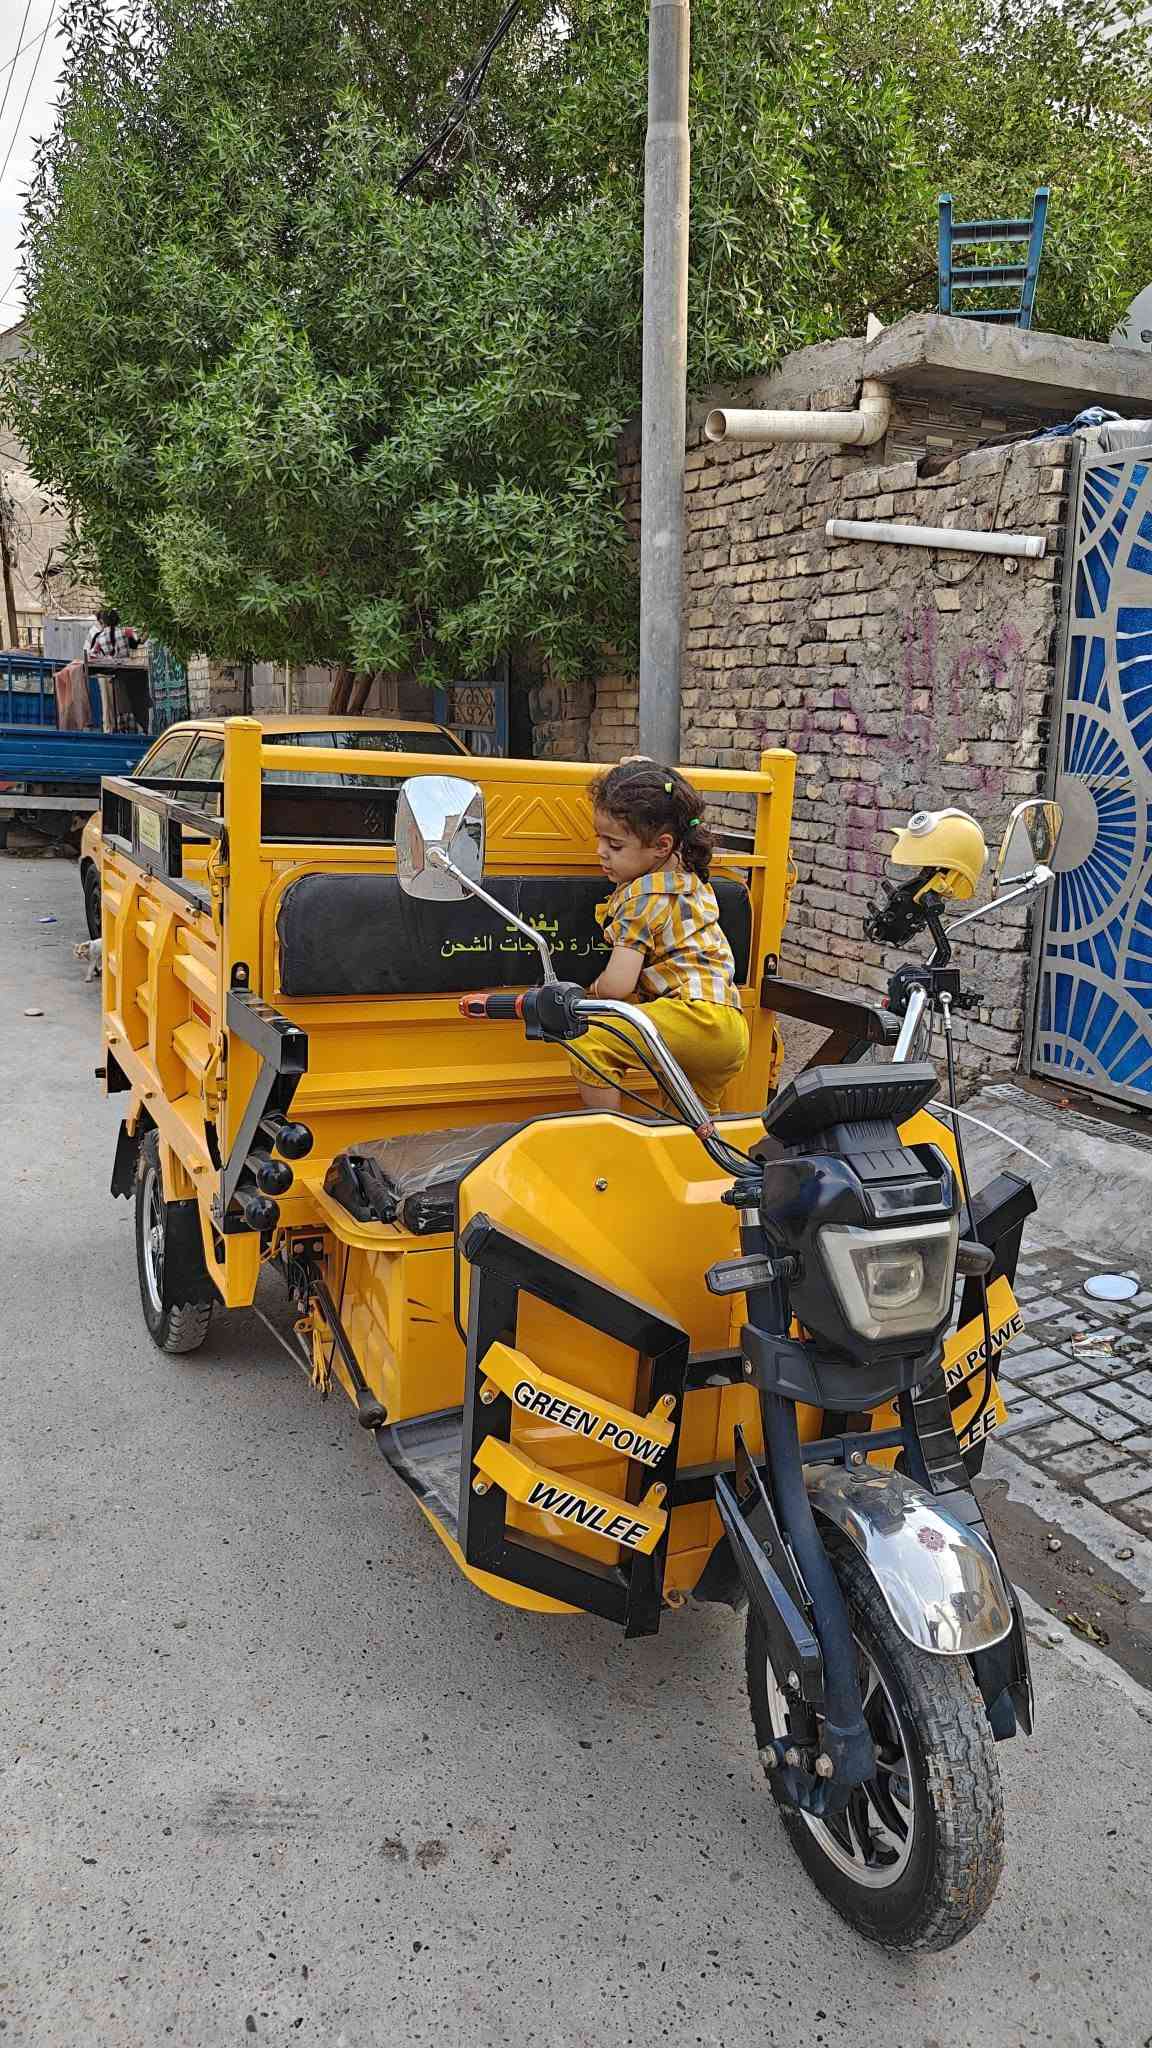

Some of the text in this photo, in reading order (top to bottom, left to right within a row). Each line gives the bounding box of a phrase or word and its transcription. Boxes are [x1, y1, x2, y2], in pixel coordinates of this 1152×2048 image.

[440, 934, 614, 958] جارة درجات الشحن
[513, 1380, 599, 1436] GREEN
[528, 1481, 650, 1546] WINLEE
